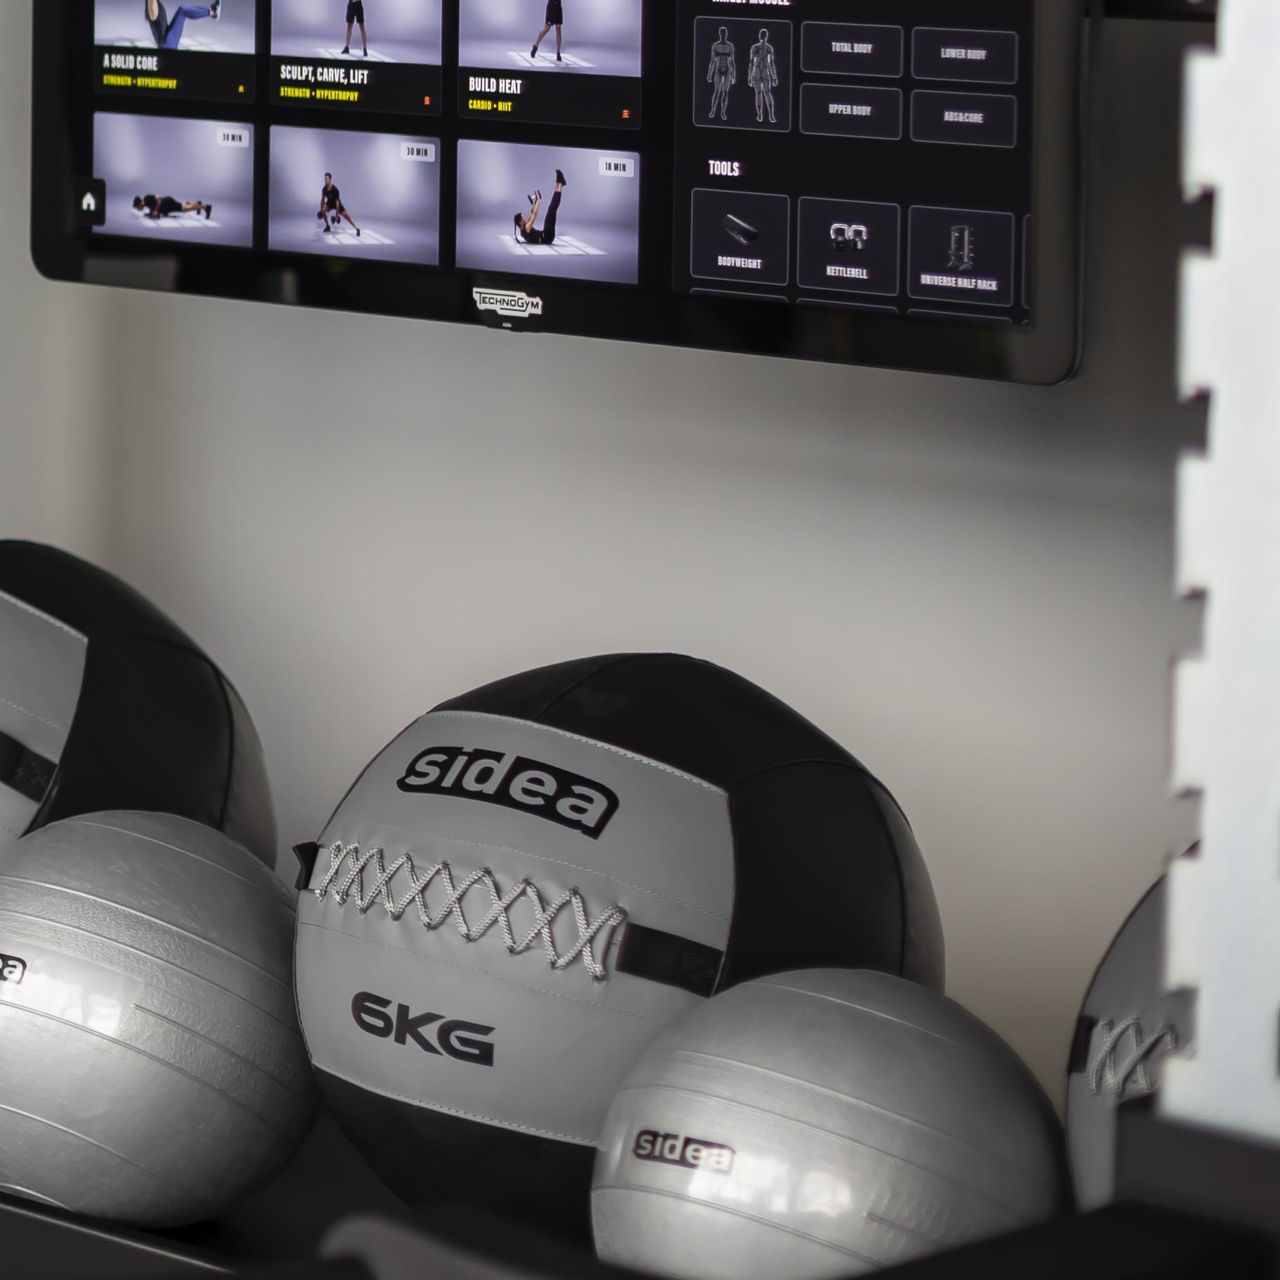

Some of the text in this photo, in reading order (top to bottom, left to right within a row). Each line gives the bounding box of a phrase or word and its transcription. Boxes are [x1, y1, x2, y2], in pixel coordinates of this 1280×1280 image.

[832, 42, 872, 54] TOTAL BODY
[941, 48, 987, 60] LOWER BODY
[103, 53, 158, 71] A SOLID CORE
[280, 65, 368, 85] SCULPT, CARVE, LIFT
[469, 76, 522, 94] BUILD HEAT
[280, 86, 359, 102] STRENGTH HYPERTROPHY
[468, 99, 492, 110] CARDIO
[829, 104, 871, 116] UPPER BODY
[231, 134, 242, 142] MIN
[416, 148, 428, 157] MIN
[614, 163, 626, 172] MIN
[708, 160, 740, 176] TOOLS
[718, 255, 762, 269] BODYWEIGHT
[826, 266, 868, 279] KETTLEBELL
[403, 747, 610, 830] sidea
[351, 991, 496, 1067] 6KG
[636, 1131, 733, 1172] sidea
